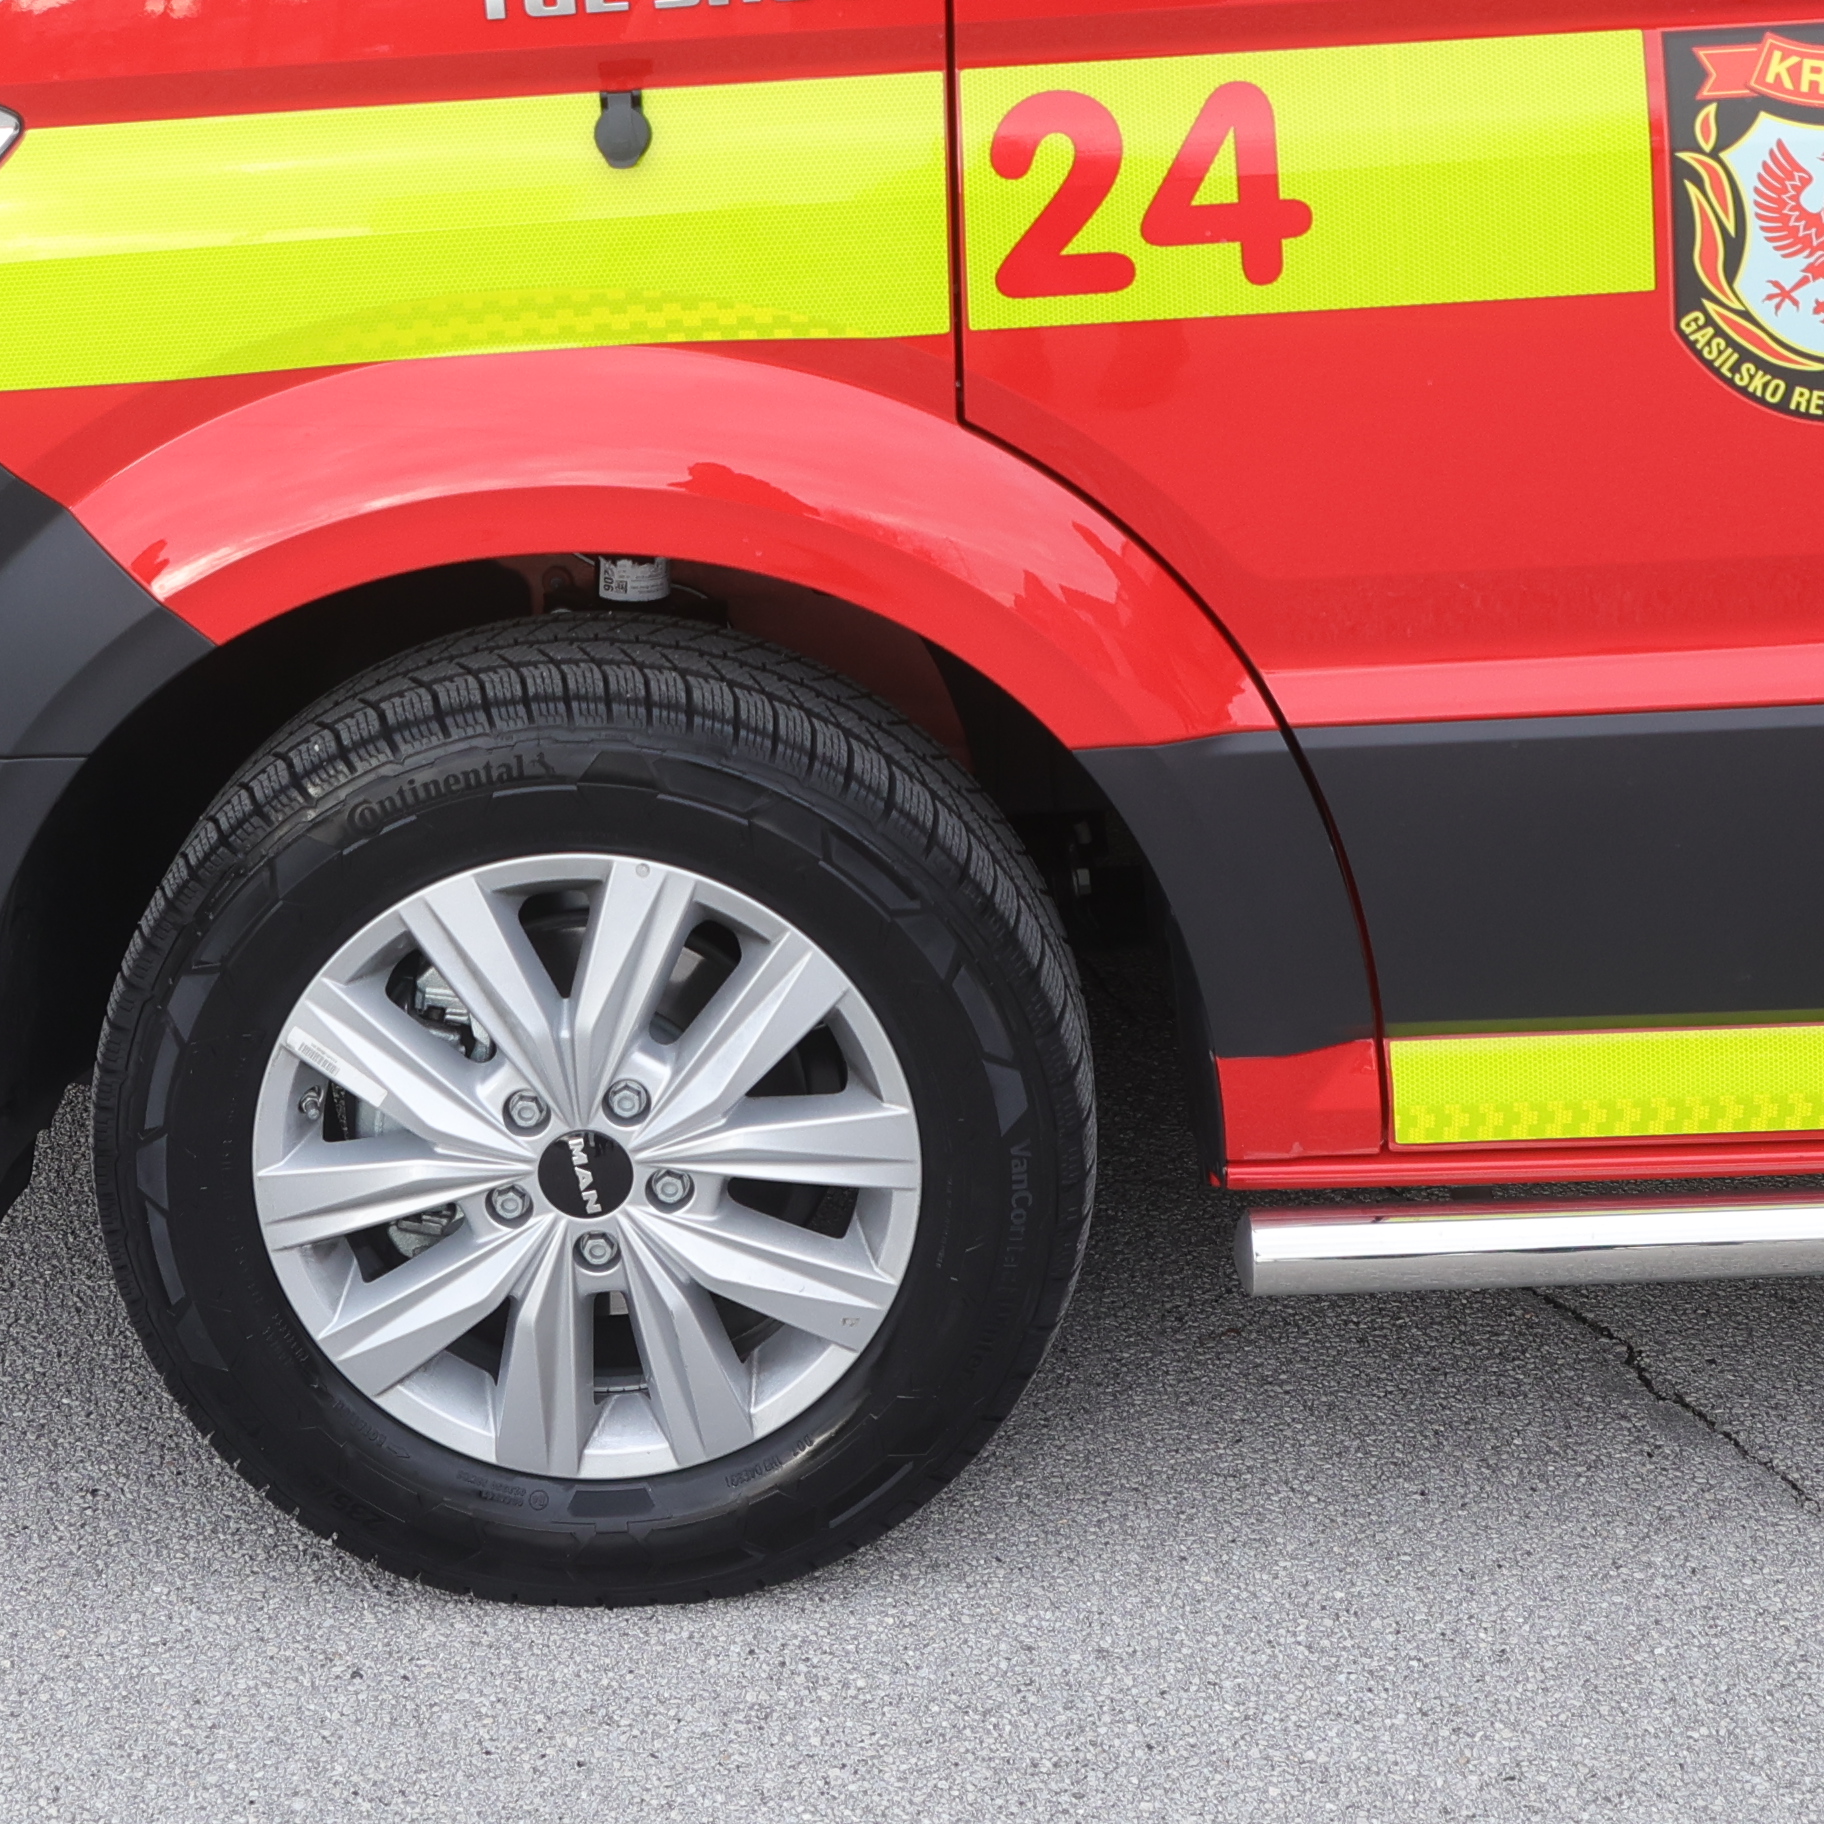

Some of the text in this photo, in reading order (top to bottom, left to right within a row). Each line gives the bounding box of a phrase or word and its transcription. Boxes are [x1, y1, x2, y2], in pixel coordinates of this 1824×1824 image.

[989, 80, 1314, 299] 24
[1679, 310, 1786, 404] GASILSKO
[346, 754, 524, 835] Continental
[568, 1138, 602, 1214] MAN
